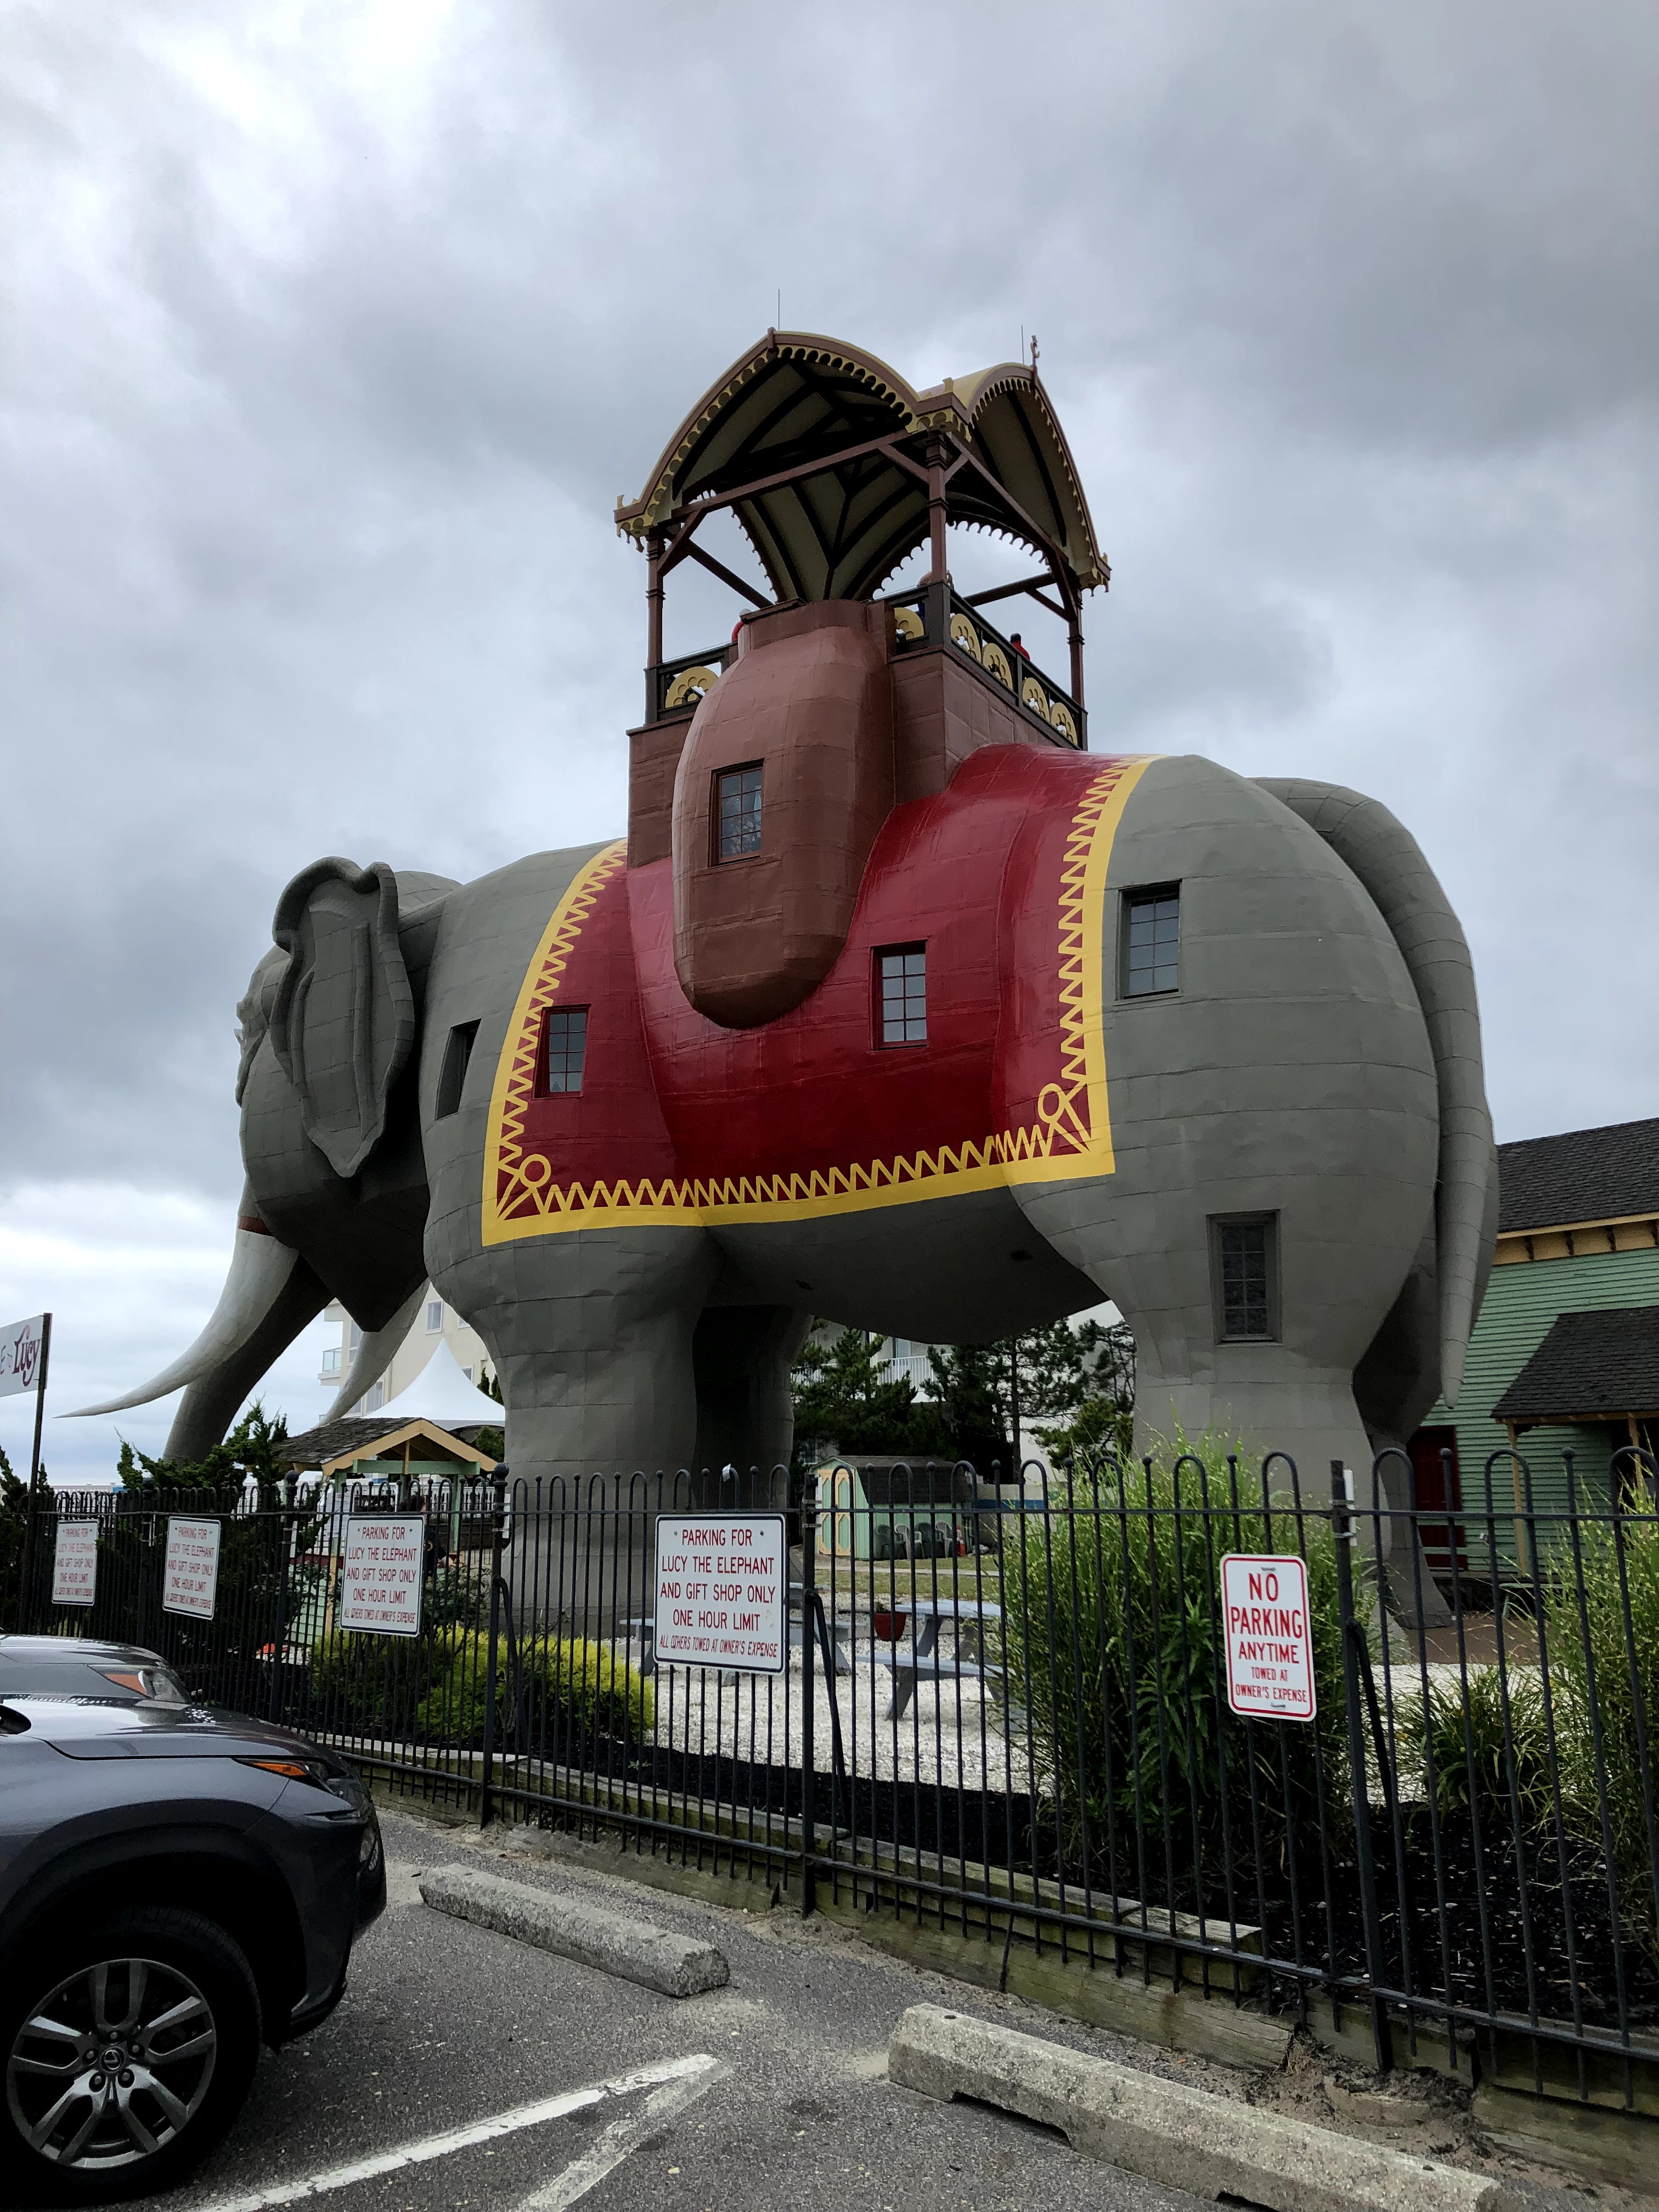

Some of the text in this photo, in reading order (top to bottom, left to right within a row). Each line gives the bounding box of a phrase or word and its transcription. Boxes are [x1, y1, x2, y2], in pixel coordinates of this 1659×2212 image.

[12, 1325, 42, 1386] Lucy
[178, 1526, 207, 1539] PARKING FOR
[362, 1527, 405, 1540] PARKING FOR
[682, 1529, 752, 1546] PARKING FOR
[169, 1543, 180, 1553] LUCY
[191, 1545, 215, 1558] ELEPHANT
[348, 1547, 417, 1561] LUCY THE ELEPHANT
[167, 1559, 213, 1576] AND GIFT SHOP ONLY
[662, 1555, 774, 1575] LUCY THE ELEPHANT
[346, 1567, 416, 1583] AND GIFT SHOP ONLY
[172, 1577, 206, 1592] ONE HOUR LIMIT
[661, 1582, 776, 1604] AND GIFT SHOP ONLY
[1248, 1573, 1279, 1601] NO
[353, 1588, 407, 1604] ONE HOUR LIMIT
[673, 1609, 760, 1631] ONE HOUR LIMIT
[1230, 1606, 1302, 1639] PARKING
[659, 1635, 778, 1657] ALL OTHERS TOWED AT OWNER'S EXPENSE
[1239, 1641, 1299, 1664] ANYTIME
[1251, 1667, 1288, 1681] TOWED AT
[1235, 1684, 1307, 1703] OWNER'S EXPENSE
